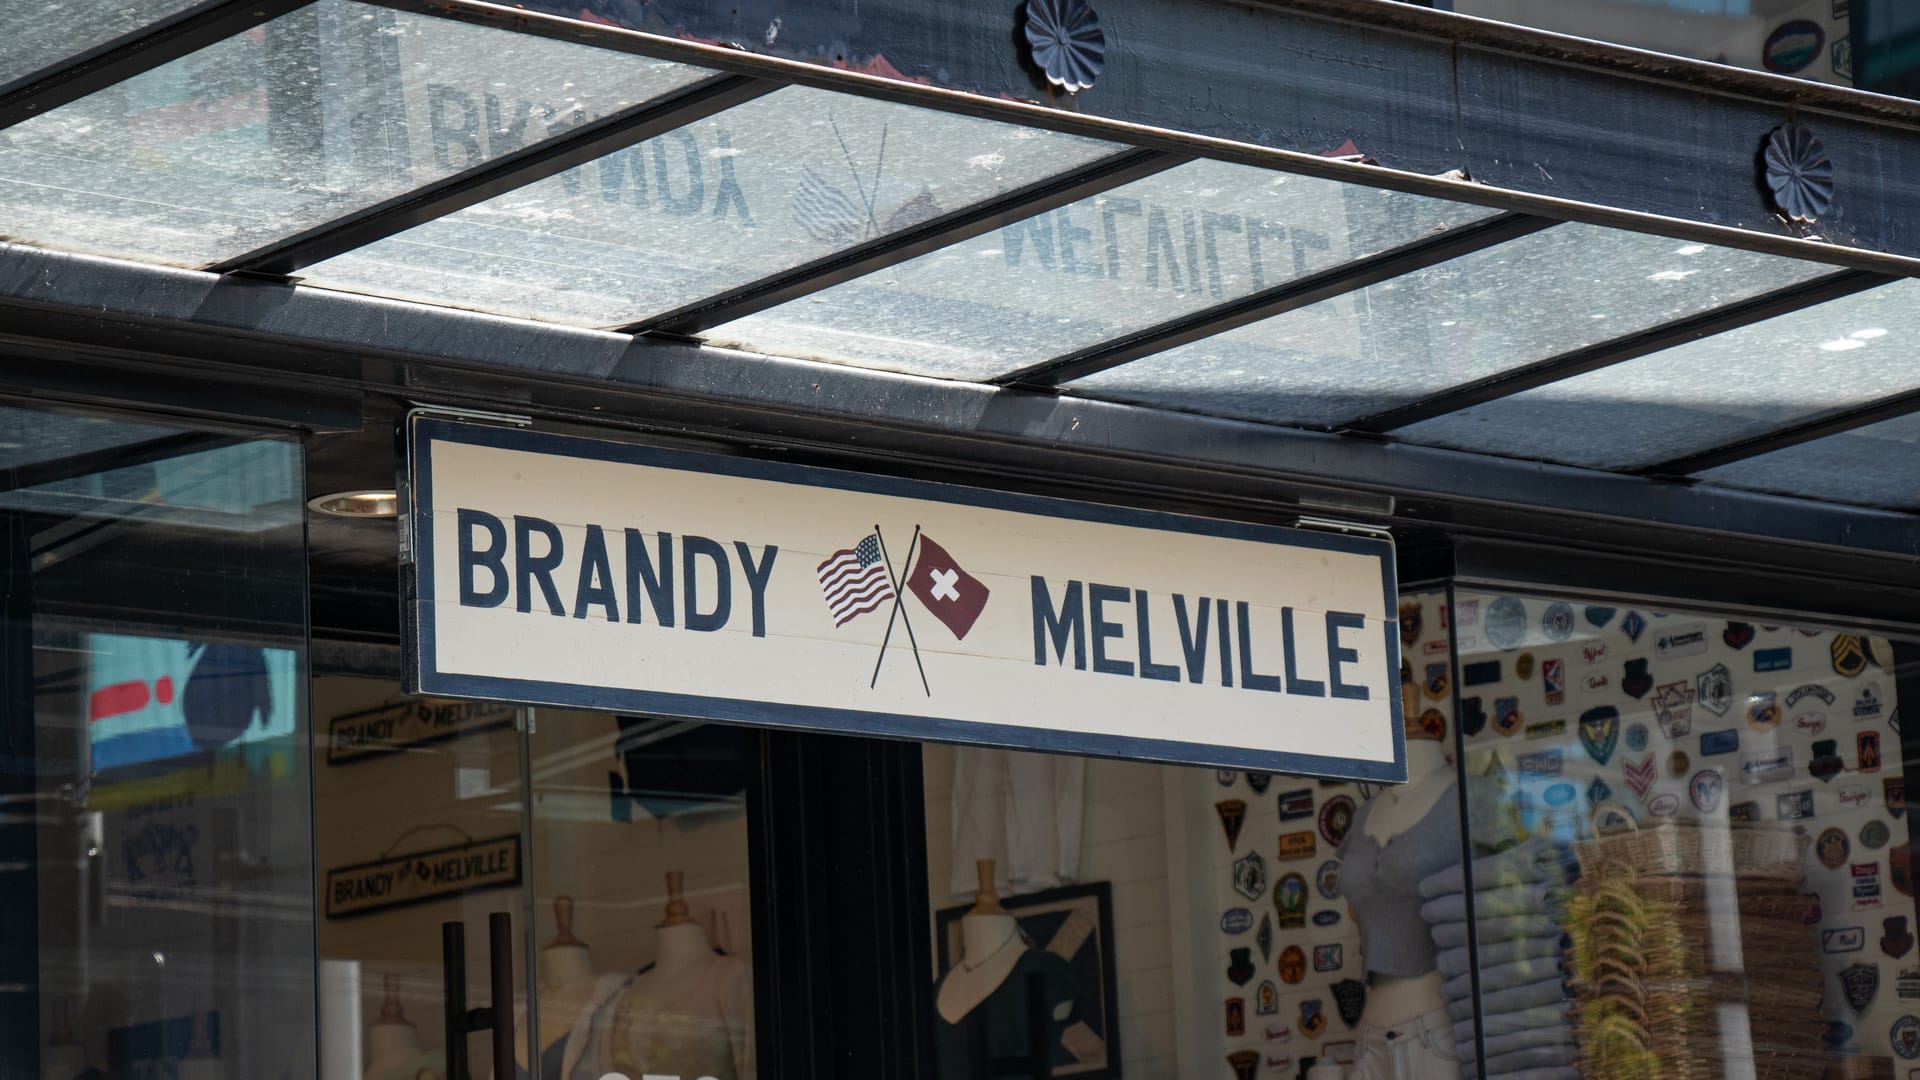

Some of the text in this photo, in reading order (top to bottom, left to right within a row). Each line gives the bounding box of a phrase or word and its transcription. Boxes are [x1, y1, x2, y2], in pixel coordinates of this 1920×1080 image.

[457, 508, 1370, 701] BRANDY MELVILLE
[335, 850, 508, 904] BRANDY MELVILLE
